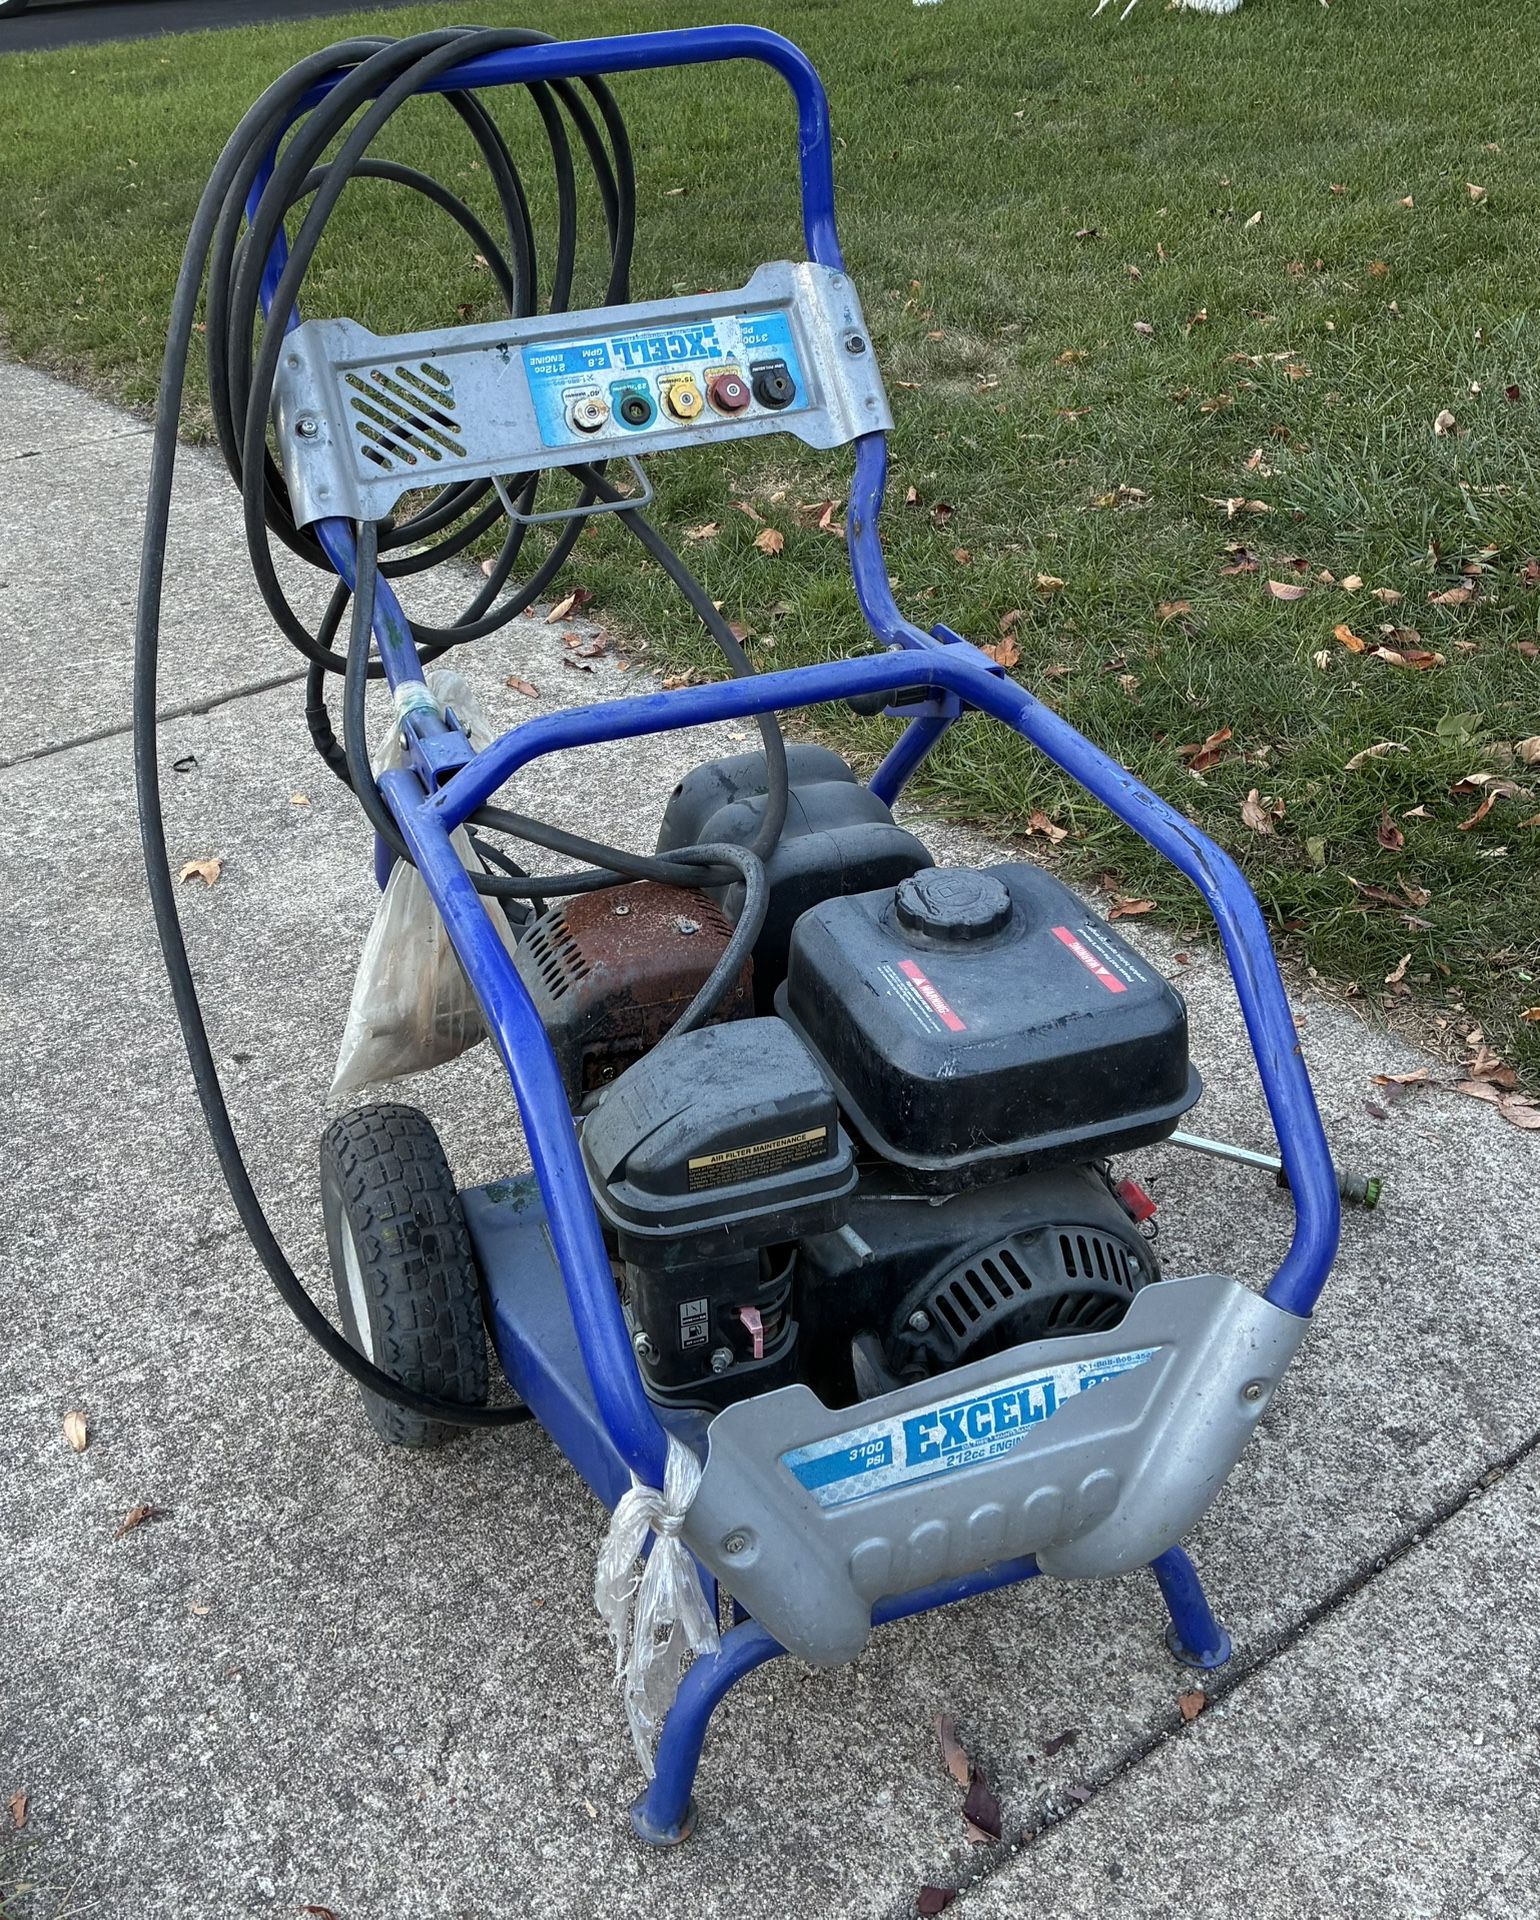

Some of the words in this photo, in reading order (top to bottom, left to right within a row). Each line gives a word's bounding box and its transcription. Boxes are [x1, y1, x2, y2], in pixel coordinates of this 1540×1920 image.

[741, 331, 769, 344] 3100
[530, 352, 564, 366] ENGINE
[582, 349, 604, 359] GPM
[534, 362, 566, 375] 212cc
[588, 358, 605, 367] 2.8
[1068, 941, 1101, 968] WARNING
[921, 984, 950, 1015] WARNING
[710, 1155, 725, 1164] AIR
[725, 1147, 752, 1160] FILTER
[753, 1133, 807, 1154] MAINTENANCE
[849, 1440, 885, 1461] 3100
[946, 1448, 986, 1467] 212cc
[866, 1454, 885, 1469] PSI
